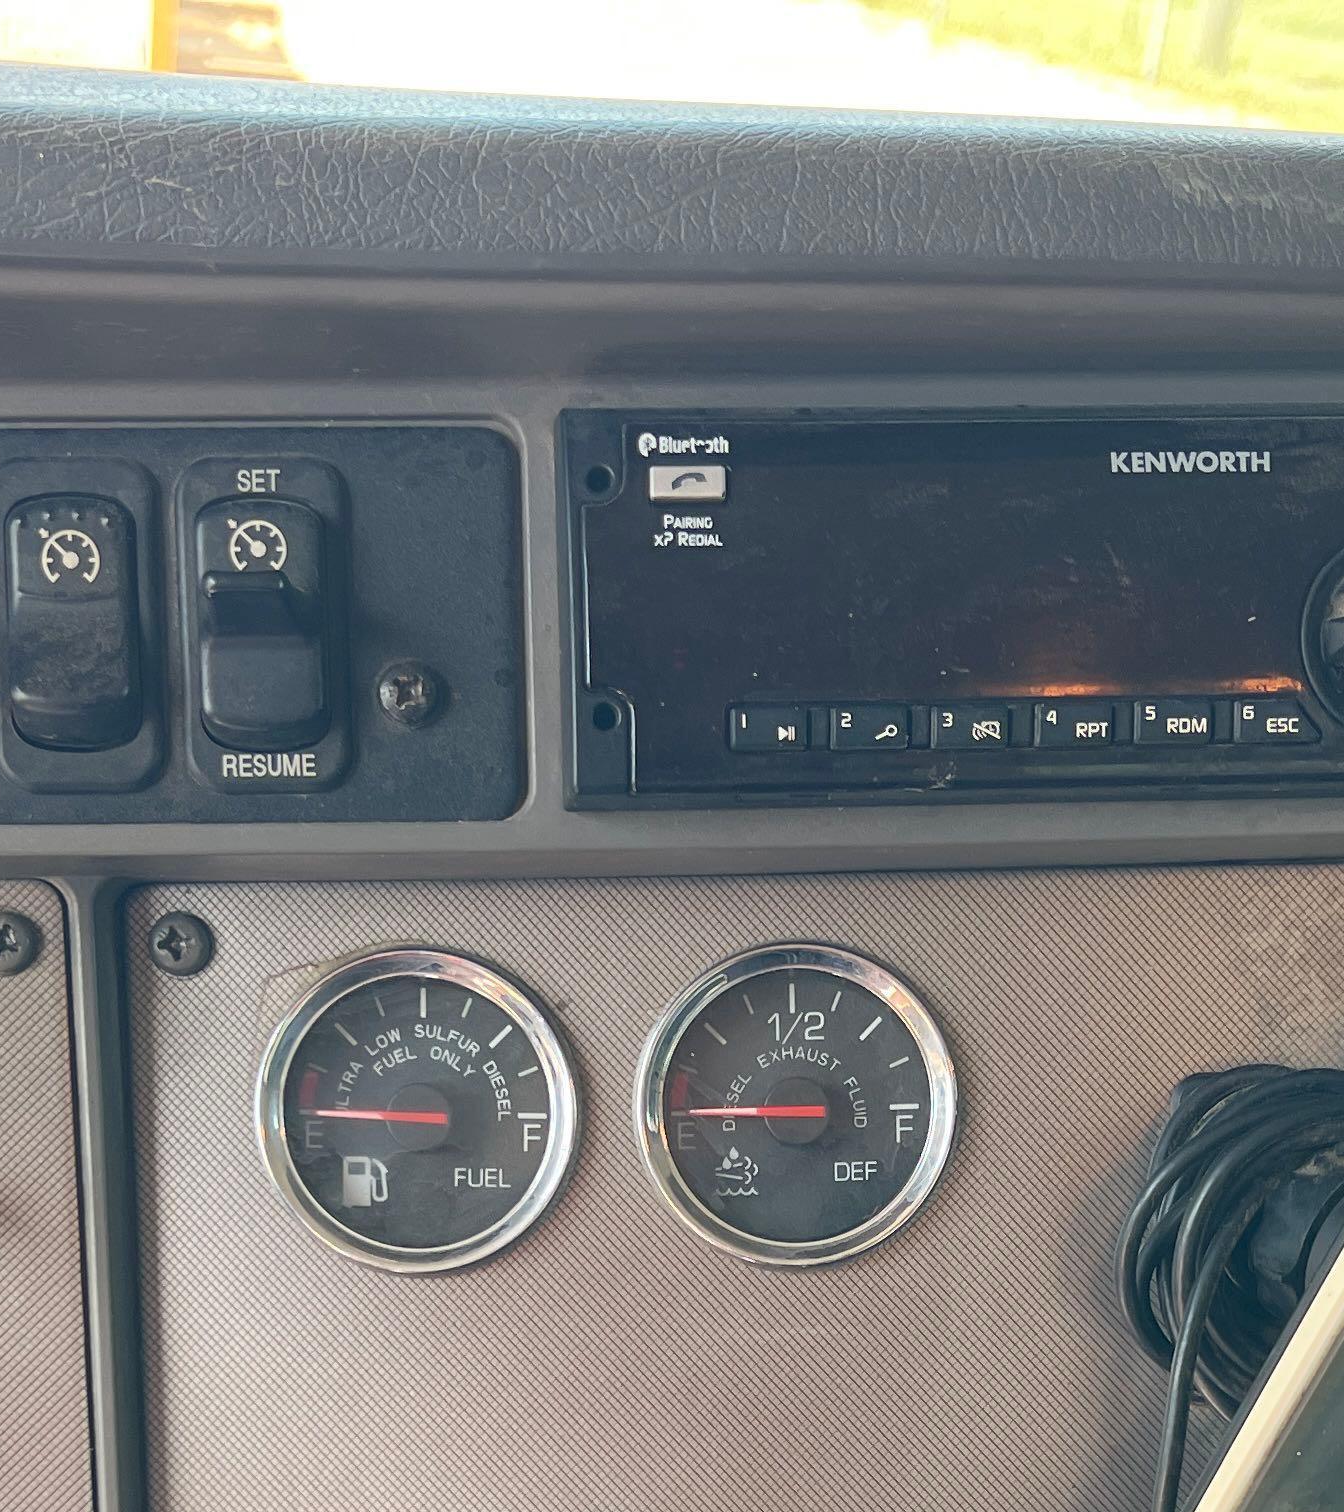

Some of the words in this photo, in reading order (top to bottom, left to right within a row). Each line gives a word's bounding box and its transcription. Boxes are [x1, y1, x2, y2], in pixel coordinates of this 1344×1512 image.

[1109, 450, 1272, 474] KENWORTH
[237, 468, 281, 494] SET
[741, 712, 748, 729] 1
[840, 712, 853, 728] 2
[942, 712, 954, 728] 3
[1045, 709, 1058, 725] 4
[1144, 705, 1157, 721] 5
[1242, 705, 1255, 720] 6
[1075, 721, 1109, 739] RPT
[1166, 716, 1208, 735] RDM
[1265, 717, 1300, 734] ESC
[221, 753, 317, 778] RESUME
[767, 1011, 826, 1045] 1/2
[372, 1046, 419, 1077] FUEL
[429, 1045, 477, 1080] ONLY
[756, 1046, 843, 1072] EXHAUST
[364, 1027, 402, 1056] LOW
[413, 1023, 481, 1058] SULFUR
[482, 1060, 512, 1122] DIESEL
[721, 1074, 753, 1131] DISEL
[843, 1075, 869, 1129] FLUID
[522, 1123, 542, 1152] F
[894, 1114, 914, 1143] F
[453, 1167, 512, 1190] FUEL
[833, 1160, 878, 1183] DEF
